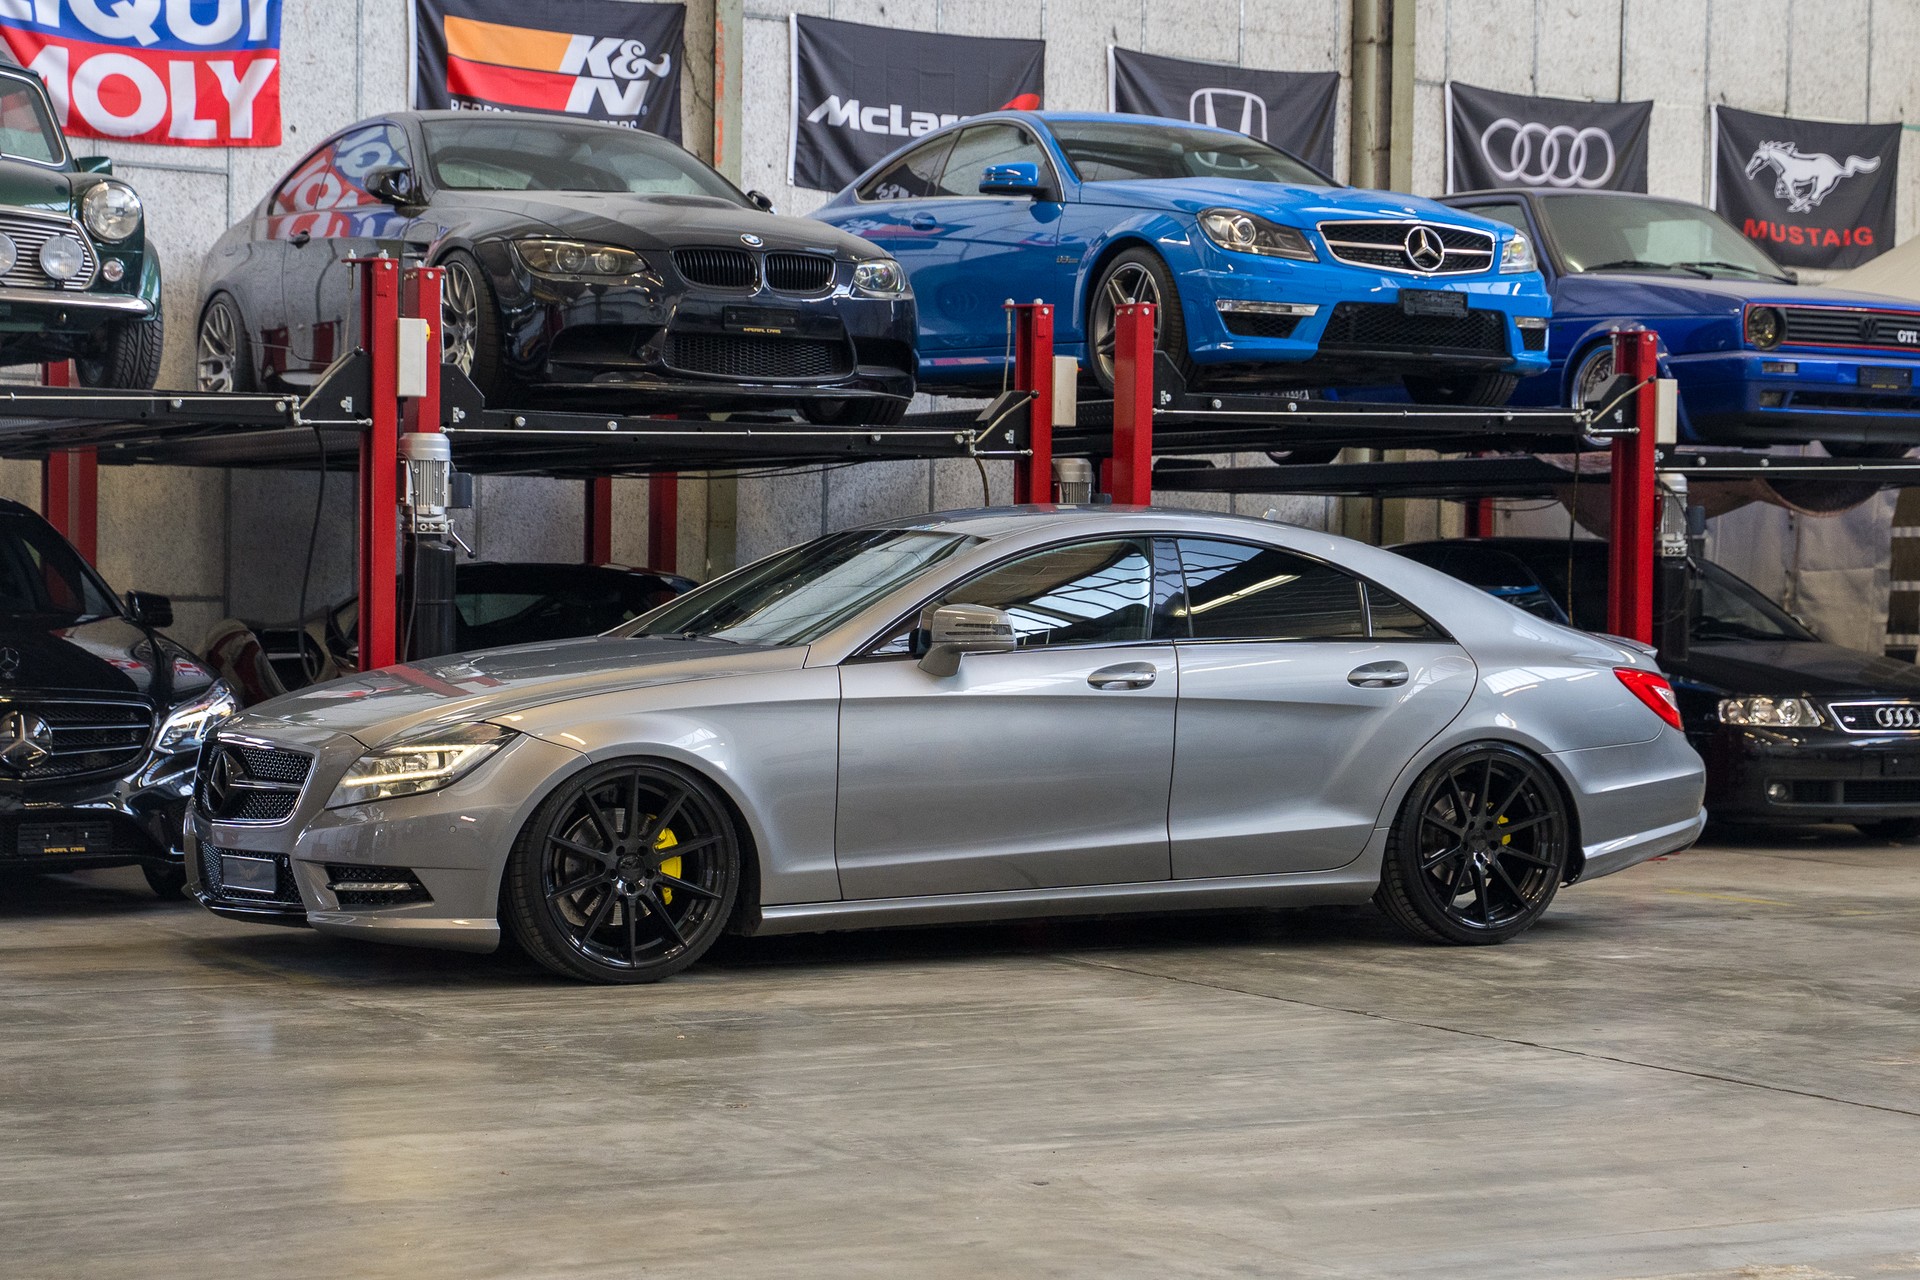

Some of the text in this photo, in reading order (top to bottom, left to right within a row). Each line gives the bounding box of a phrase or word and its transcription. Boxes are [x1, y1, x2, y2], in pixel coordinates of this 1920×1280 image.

[0, 0, 268, 46] QUI
[0, 36, 278, 140] MOLY
[807, 95, 976, 138] McLar
[1897, 329, 1918, 344] GTI
